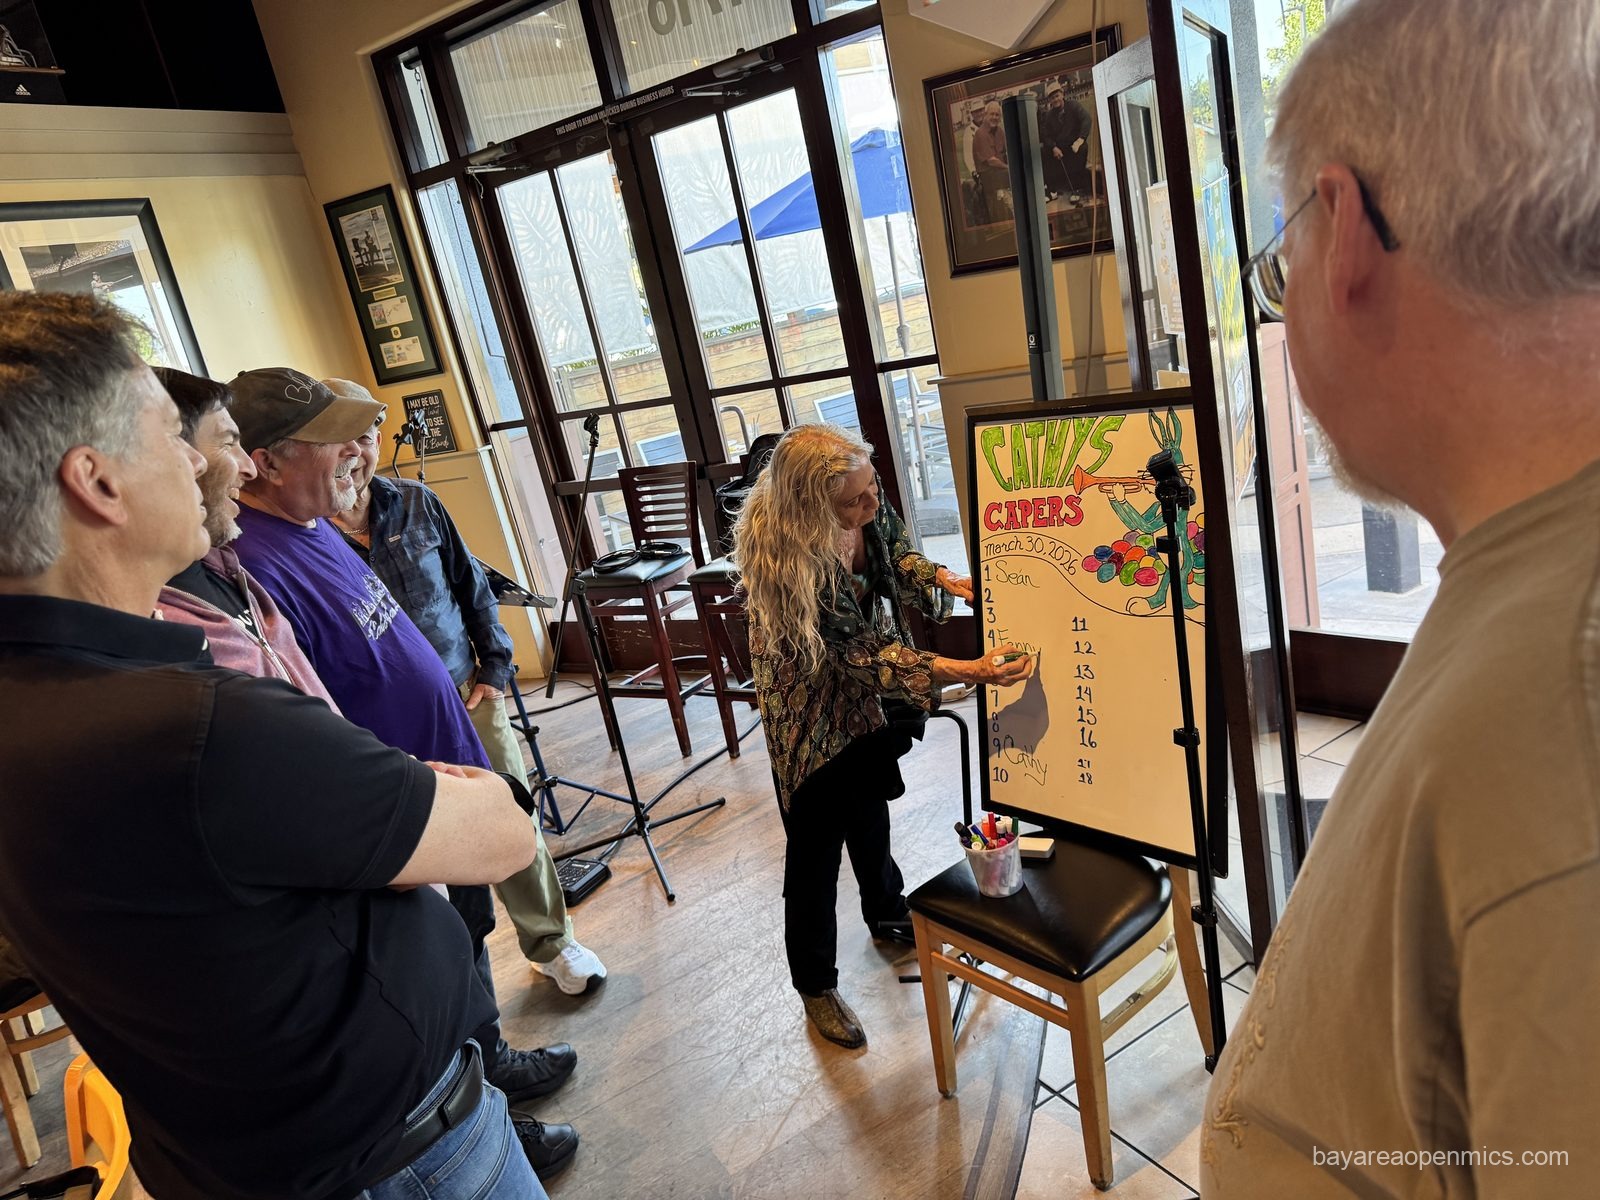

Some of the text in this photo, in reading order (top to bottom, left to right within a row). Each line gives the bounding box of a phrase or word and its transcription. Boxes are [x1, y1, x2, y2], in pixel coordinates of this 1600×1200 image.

[555, 126, 566, 136] THIS
[565, 123, 577, 133] DOOR
[581, 115, 599, 127] REMAIN
[619, 99, 637, 112] DURING
[636, 91, 659, 106] BUSINESS
[658, 85, 675, 97] HOURS
[410, 398, 421, 409] MAY
[420, 397, 429, 407] BE
[429, 395, 440, 405] OLD
[426, 418, 433, 427] TO
[433, 416, 444, 426] SEE
[430, 427, 442, 438] THE
[983, 494, 1084, 531] CAPERS
[1025, 536, 1046, 555] 30,
[1048, 541, 1078, 575] 2026
[984, 564, 991, 581] 1
[984, 588, 994, 603] 2
[986, 607, 996, 623] 3
[1072, 616, 1089, 631] 11
[987, 629, 995, 648] 4
[1073, 641, 1096, 655] 12
[1073, 664, 1095, 680] 13
[991, 689, 998, 707] 7
[1075, 685, 1092, 704] 14
[1077, 705, 1097, 725] 15
[1080, 726, 1097, 748] 16
[993, 734, 1047, 786] 9 Cathy
[992, 766, 1009, 783] 10
[1078, 772, 1093, 785] 18
